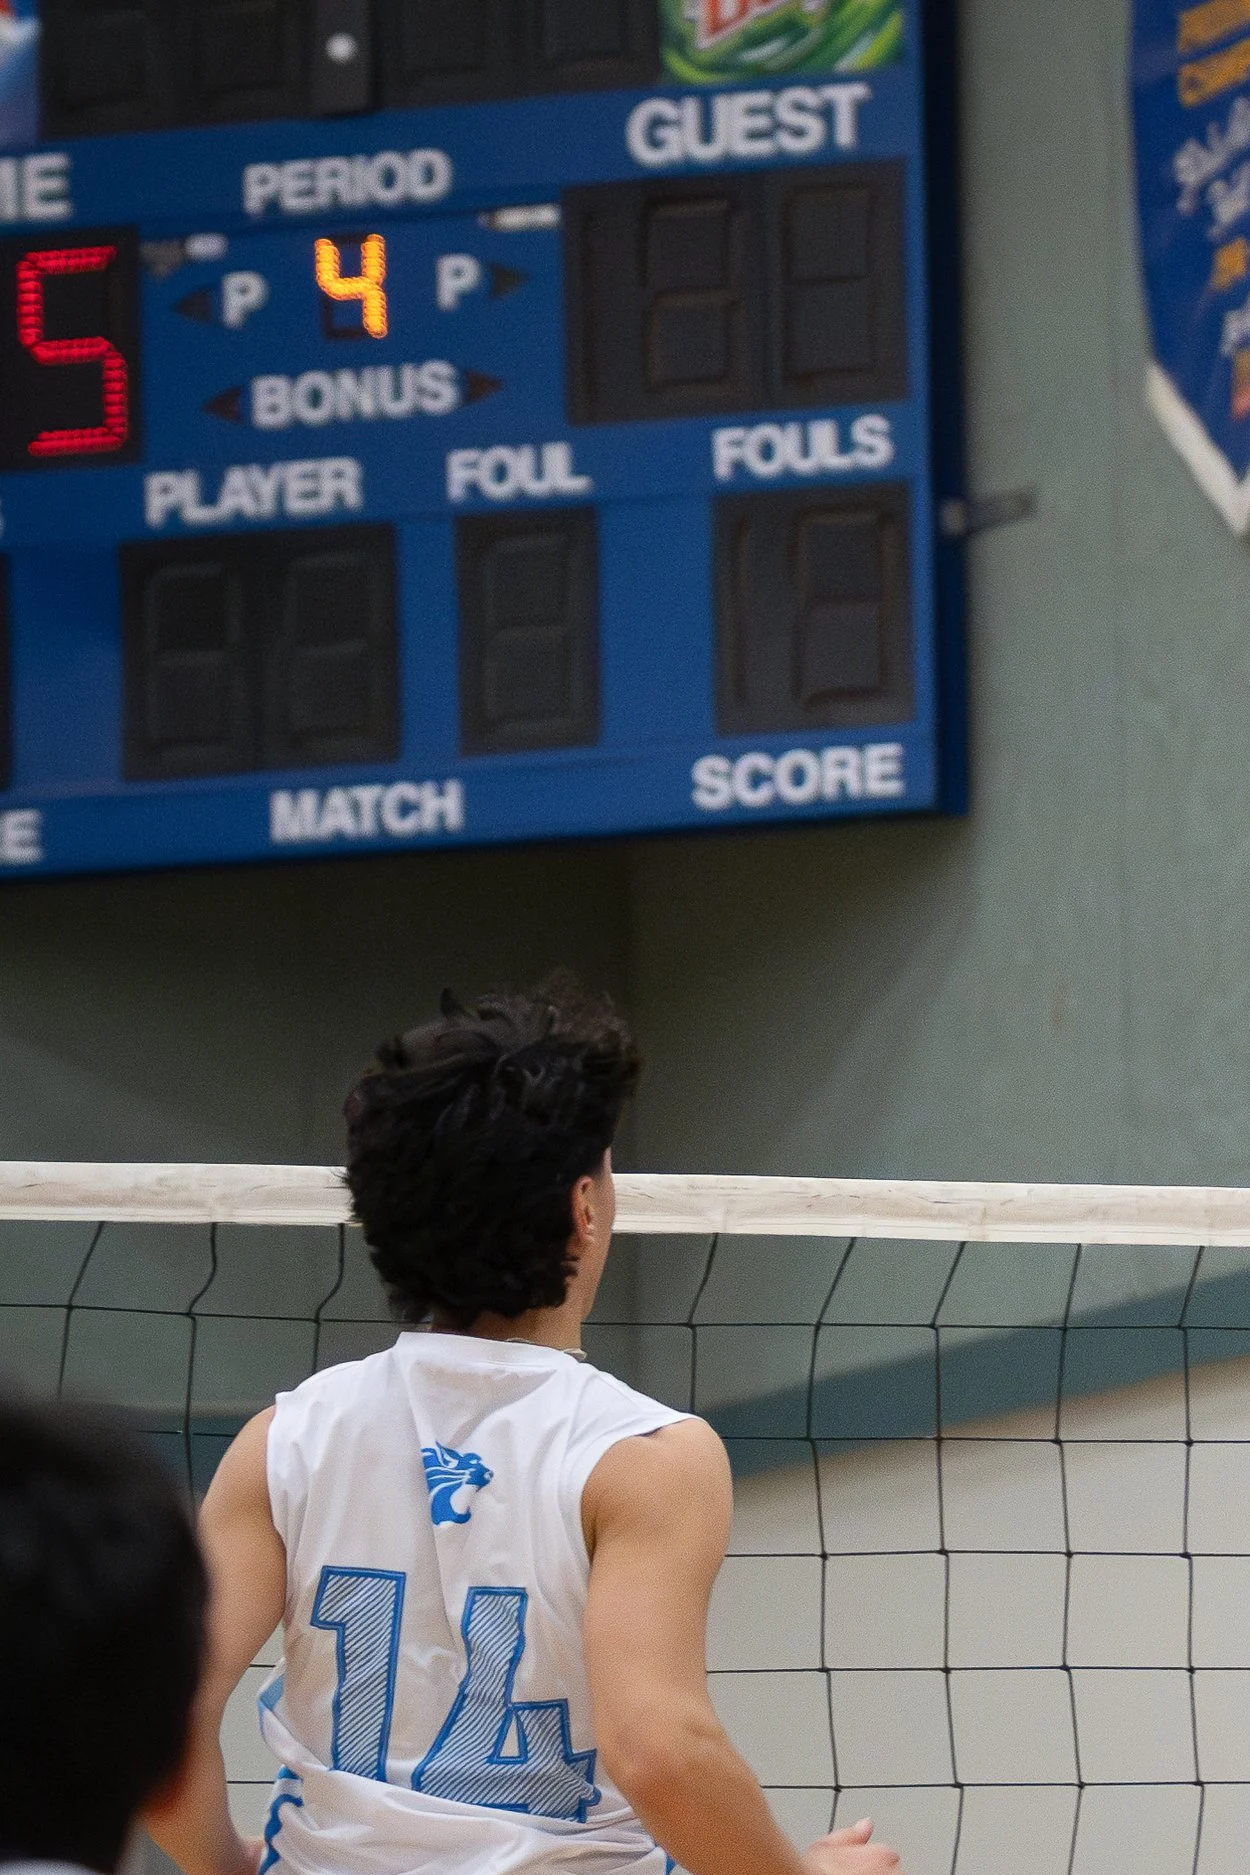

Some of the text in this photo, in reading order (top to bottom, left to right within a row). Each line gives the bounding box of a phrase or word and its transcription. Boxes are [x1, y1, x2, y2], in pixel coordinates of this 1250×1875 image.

[626, 83, 870, 165] GUEST
[242, 149, 453, 215] PERIOD
[221, 270, 269, 328] P
[314, 233, 388, 338] 4
[436, 252, 481, 310] P
[16, 245, 128, 456] 5
[251, 361, 460, 430] BONUS
[446, 442, 590, 502] FOUL
[712, 415, 893, 480] FOULS
[144, 458, 364, 526] PLAYER
[691, 743, 905, 810] SCORE
[270, 780, 465, 843] MATCH
[311, 1565, 601, 1824] 14
